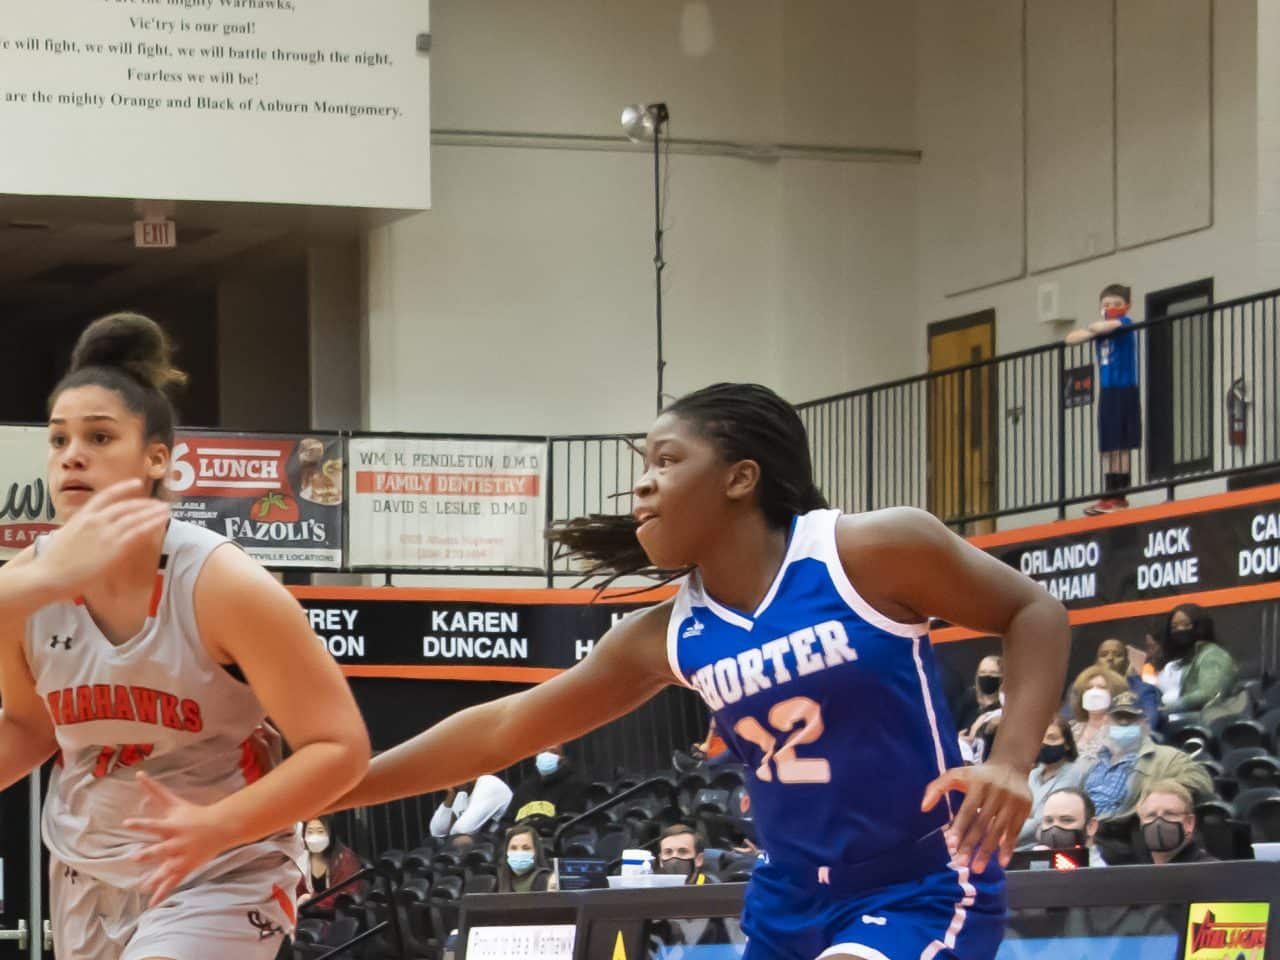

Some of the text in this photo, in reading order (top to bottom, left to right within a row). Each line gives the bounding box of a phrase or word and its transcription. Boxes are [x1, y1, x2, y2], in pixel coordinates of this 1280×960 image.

[130, 17, 255, 36] Vic'try is our goal!
[15, 38, 40, 51] will
[44, 39, 81, 55] fight,
[85, 44, 104, 54] we
[108, 42, 133, 56] will
[178, 48, 196, 58] we
[200, 46, 224, 59] will
[228, 47, 267, 61] battle
[272, 50, 325, 65] through
[330, 51, 351, 64] the
[355, 53, 393, 67] night,
[127, 68, 259, 86] Fearless we will be!
[6, 92, 27, 103] are
[32, 91, 54, 104] the
[58, 93, 105, 109] mighty
[111, 94, 162, 110] Orange
[166, 96, 192, 109] and
[196, 97, 234, 111] Black
[239, 99, 255, 112] of
[256, 100, 309, 114] Auburn
[314, 101, 403, 118] Montgomery.
[143, 223, 169, 245] EXIT
[199, 458, 280, 479] LUNCH
[375, 472, 526, 494] FAMILY DENTISTRY
[373, 499, 415, 514] DAVID
[224, 516, 326, 542] FAZOLI'S
[1144, 527, 1192, 559] JACK
[1020, 541, 1099, 575] ORLANDO
[1238, 546, 1280, 577] DOU
[1137, 557, 1199, 591] DOANE
[300, 608, 359, 630] REY
[432, 610, 518, 633] KAREN
[423, 636, 528, 659] DUNCAN
[691, 619, 859, 712] HORTER
